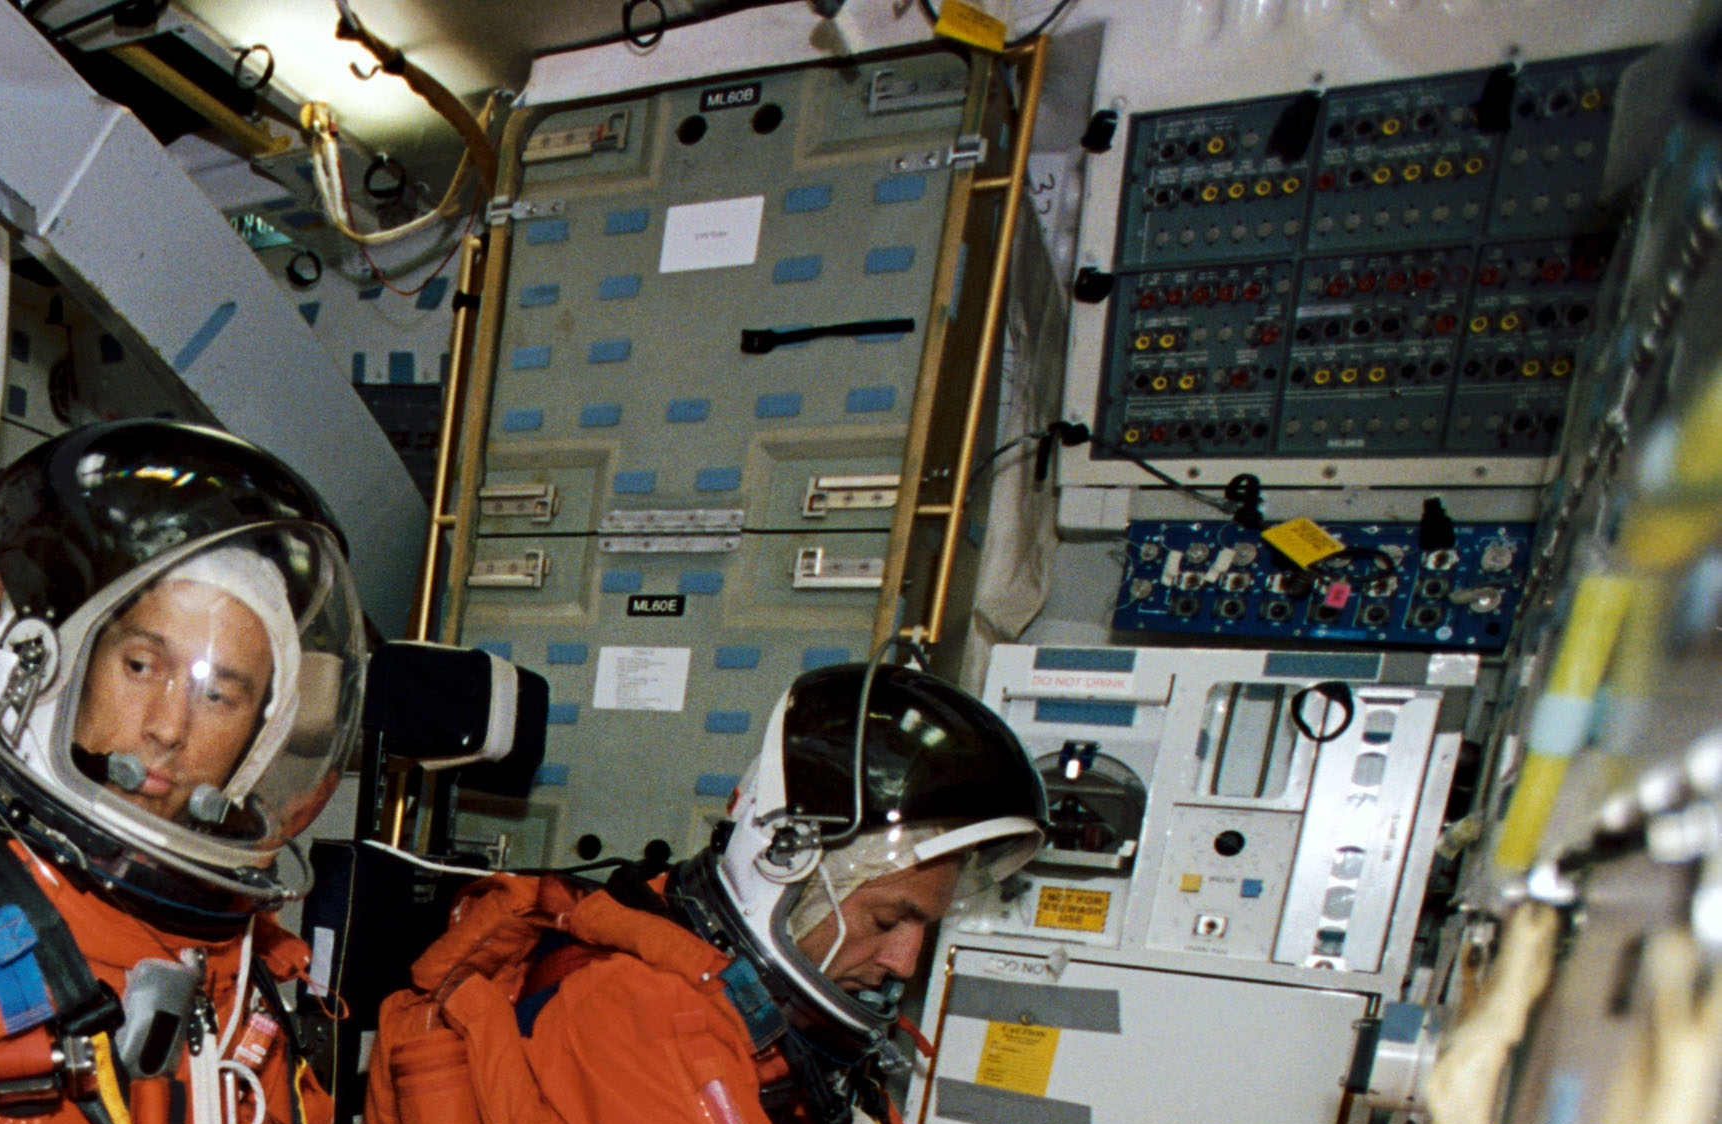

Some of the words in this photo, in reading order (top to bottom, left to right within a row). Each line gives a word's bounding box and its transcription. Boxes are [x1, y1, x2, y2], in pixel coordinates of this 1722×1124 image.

[706, 87, 754, 107] ML60B
[632, 599, 678, 612] ML60E
[1032, 675, 1052, 686] DO
[1055, 676, 1082, 687] NOT
[1085, 677, 1126, 689] DRINK
[1047, 893, 1072, 902] NOT
[1076, 895, 1103, 905] FOR
